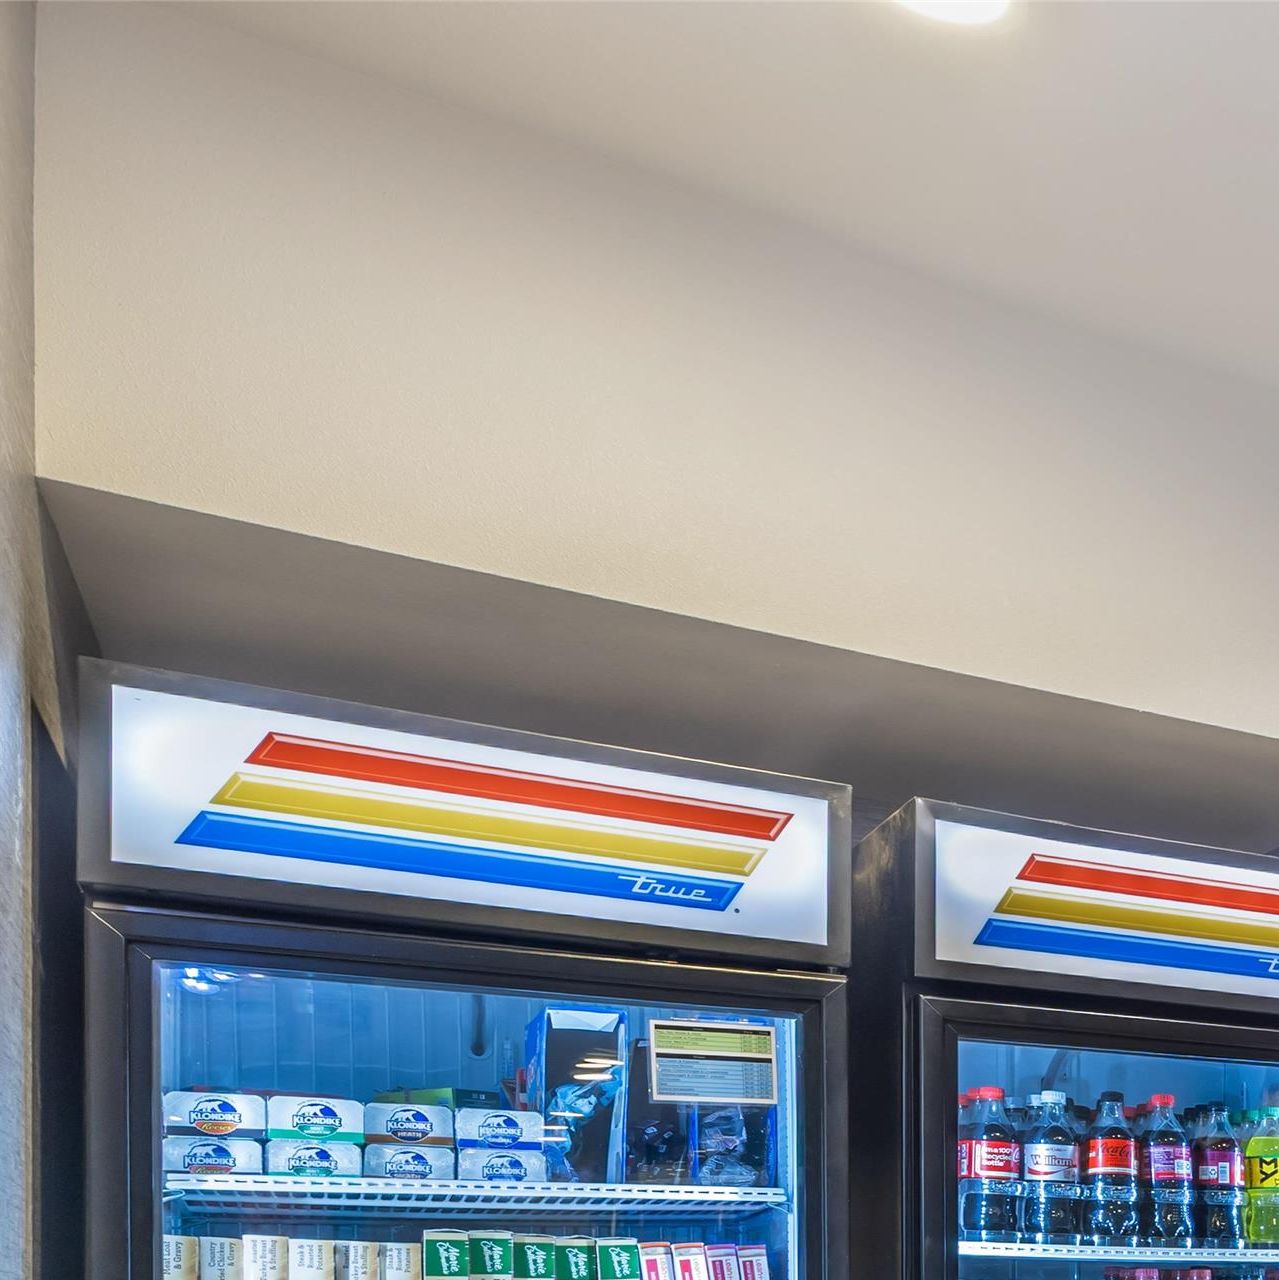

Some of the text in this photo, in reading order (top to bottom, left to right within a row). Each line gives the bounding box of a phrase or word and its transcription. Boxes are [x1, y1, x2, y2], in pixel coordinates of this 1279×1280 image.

[618, 874, 712, 902] true
[189, 1110, 242, 1125] KLONDIKE
[292, 1114, 343, 1129] KLONDIKE
[386, 1119, 433, 1133] KLONDIKE
[479, 1123, 524, 1138] KLONDIKE
[1031, 1154, 1073, 1167] William
[209, 1242, 217, 1267] Country
